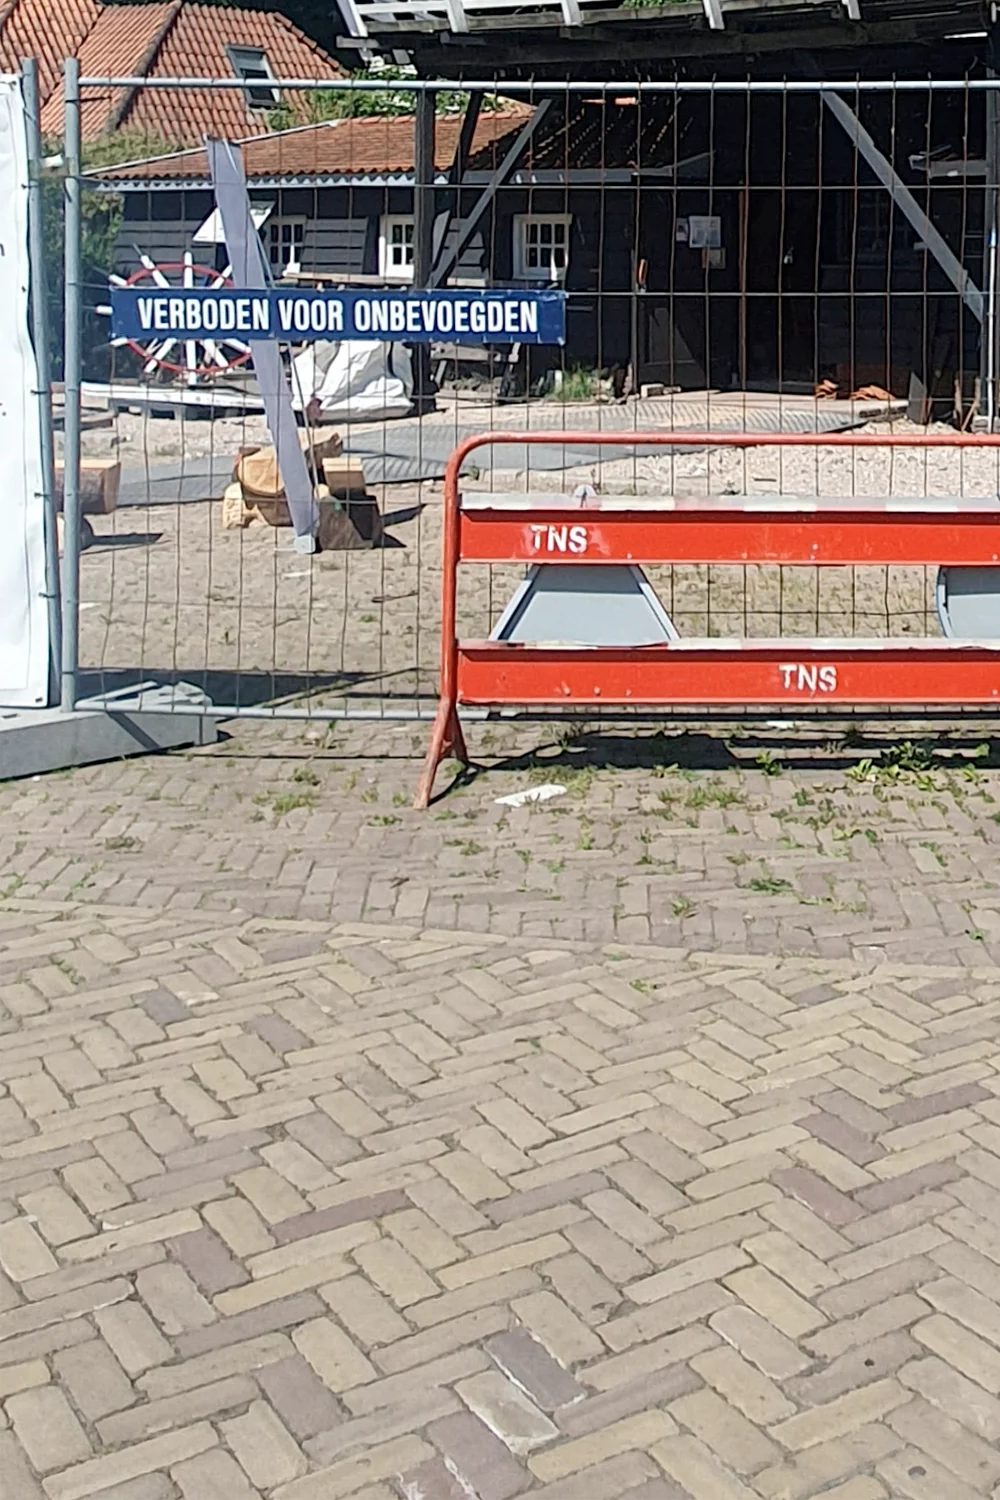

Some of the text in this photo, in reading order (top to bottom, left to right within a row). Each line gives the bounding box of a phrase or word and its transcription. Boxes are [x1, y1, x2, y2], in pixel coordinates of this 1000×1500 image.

[137, 297, 538, 333] VERBODEN VOOR ONBEVOEGDEN
[530, 524, 587, 554] TNS
[779, 663, 837, 693] TNS
